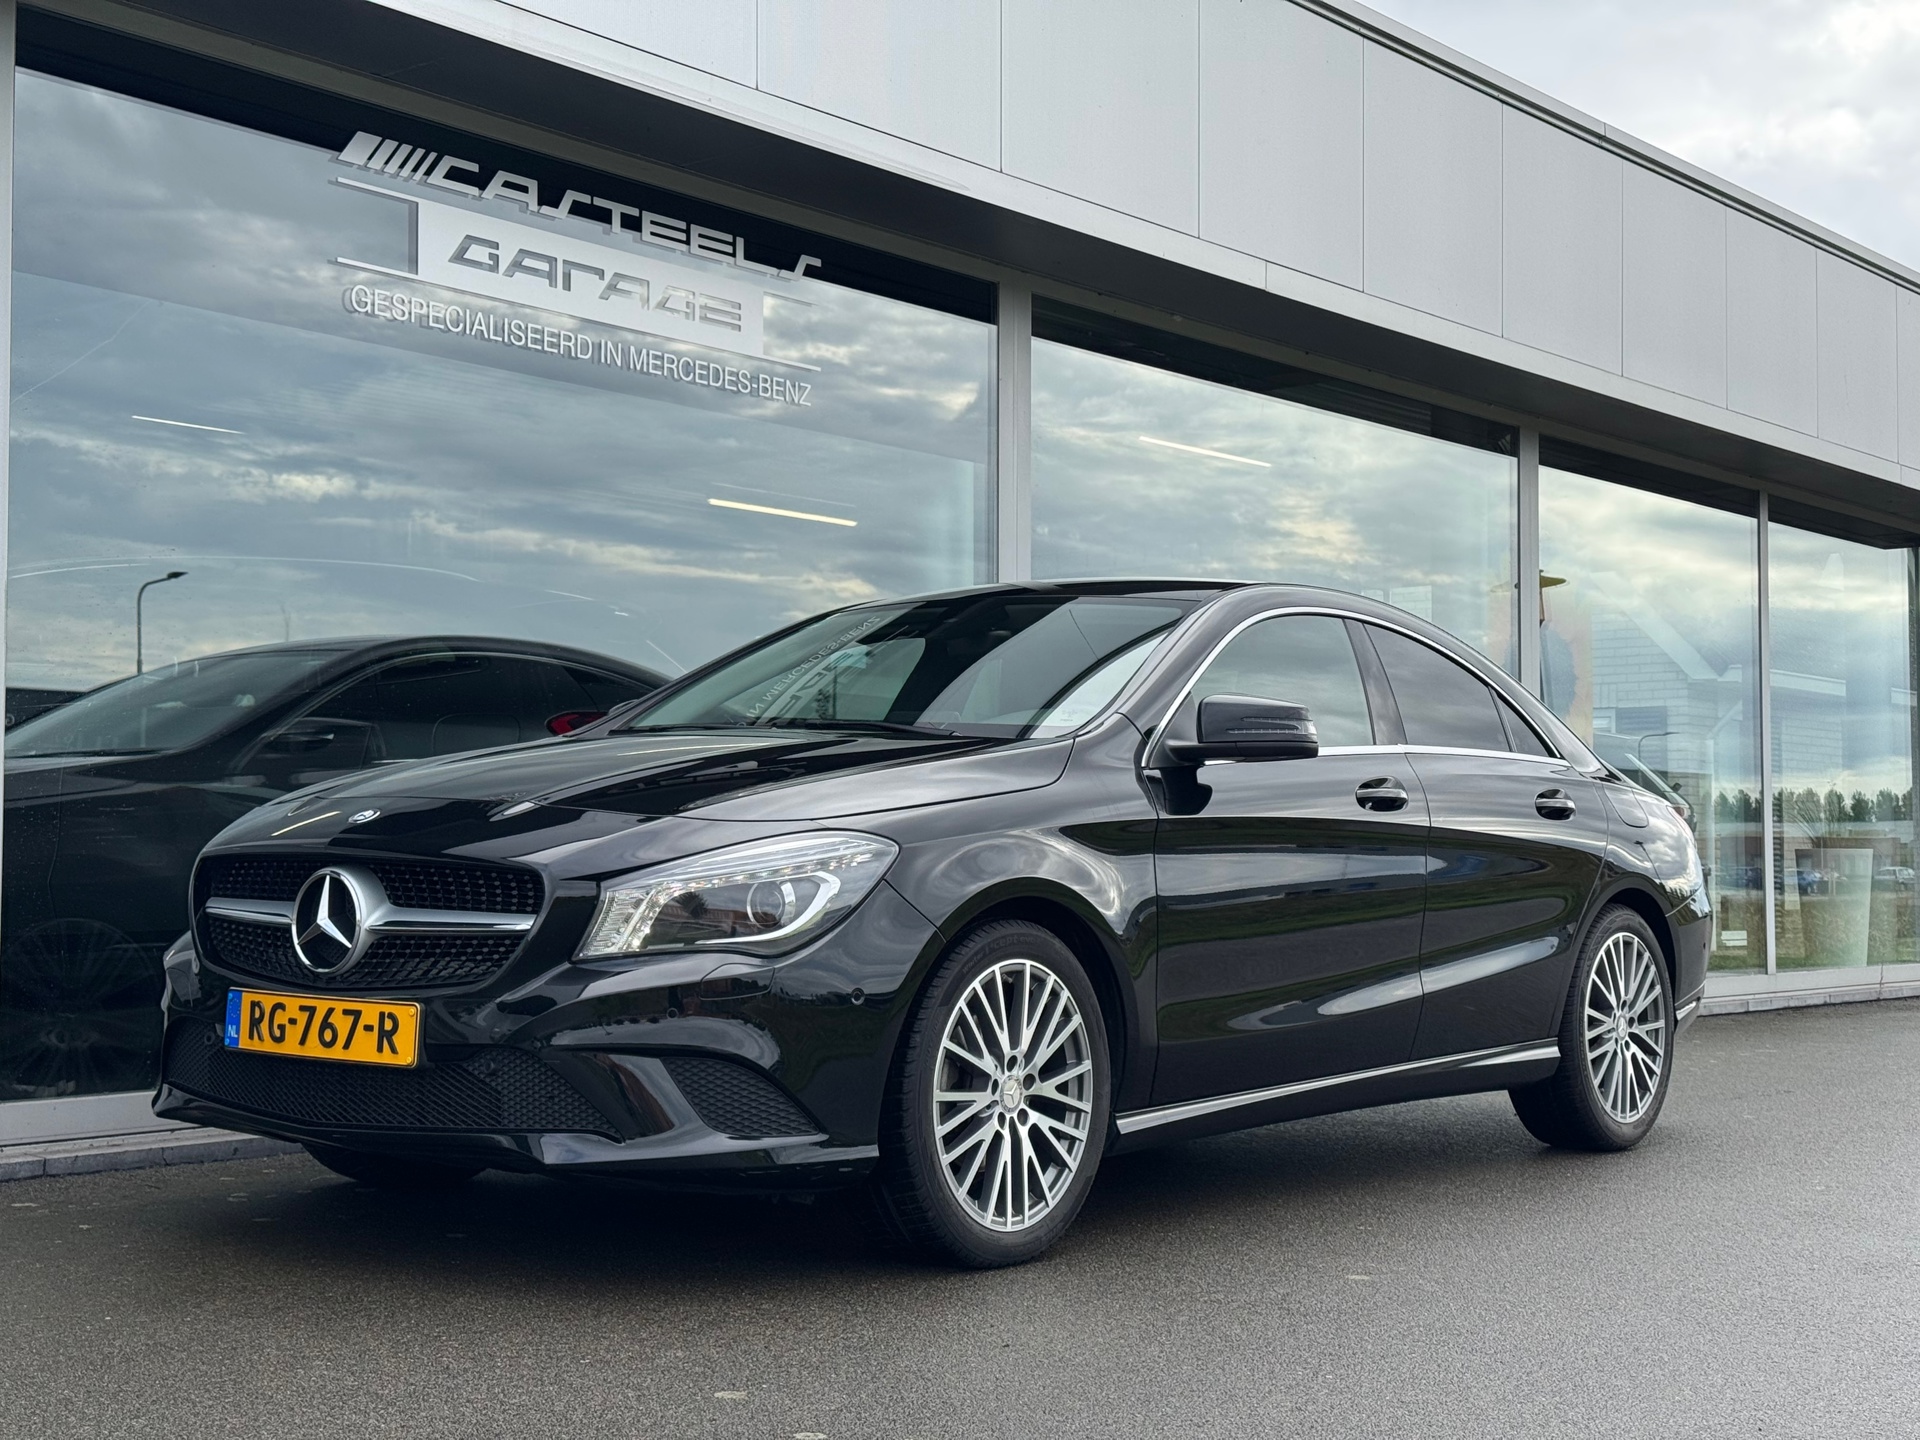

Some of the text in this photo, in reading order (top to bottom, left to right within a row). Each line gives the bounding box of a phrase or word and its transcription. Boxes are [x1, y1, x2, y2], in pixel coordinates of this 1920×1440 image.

[426, 154, 822, 281] CASTEELS
[448, 234, 742, 332] GARAGE
[351, 284, 812, 406] GESPECIALISEERD IN MERCEDES-BENZ
[227, 1023, 238, 1038] NL
[248, 999, 400, 1055] RG-767-R
